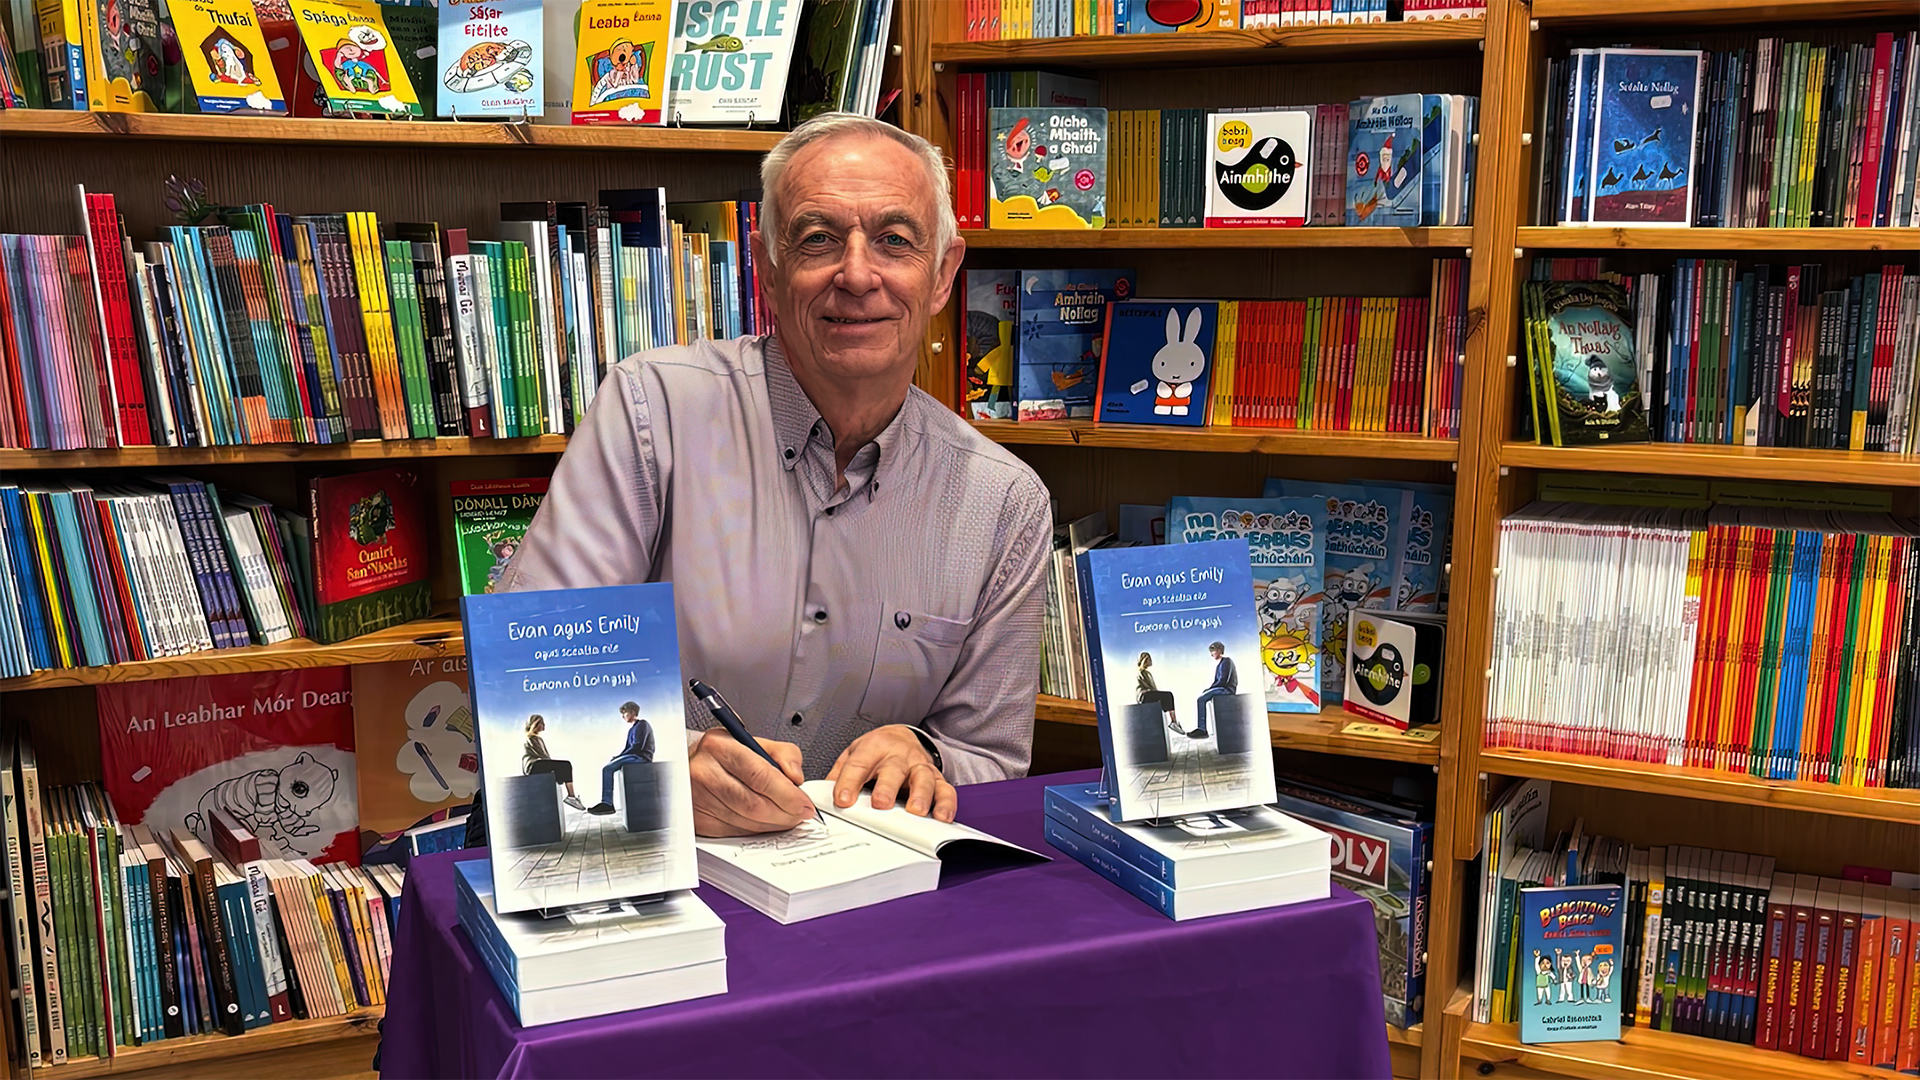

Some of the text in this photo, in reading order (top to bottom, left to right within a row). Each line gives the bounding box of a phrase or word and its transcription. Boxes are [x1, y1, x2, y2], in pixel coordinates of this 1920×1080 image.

[589, 15, 630, 29] Leaba
[745, 0, 788, 37] LE
[1049, 128, 1102, 142] Mhaith,
[1054, 292, 1105, 306] Amhráin
[1060, 306, 1099, 321] Nollag
[1570, 336, 1611, 354] Thuas
[512, 494, 545, 509] DÁN
[1121, 566, 1225, 589] Evan agus Emily
[508, 614, 640, 641] Evan agus Emily
[410, 658, 435, 677] Ar
[572, 671, 582, 688] Ó
[126, 688, 352, 735] An Leabhar Mór Dear
